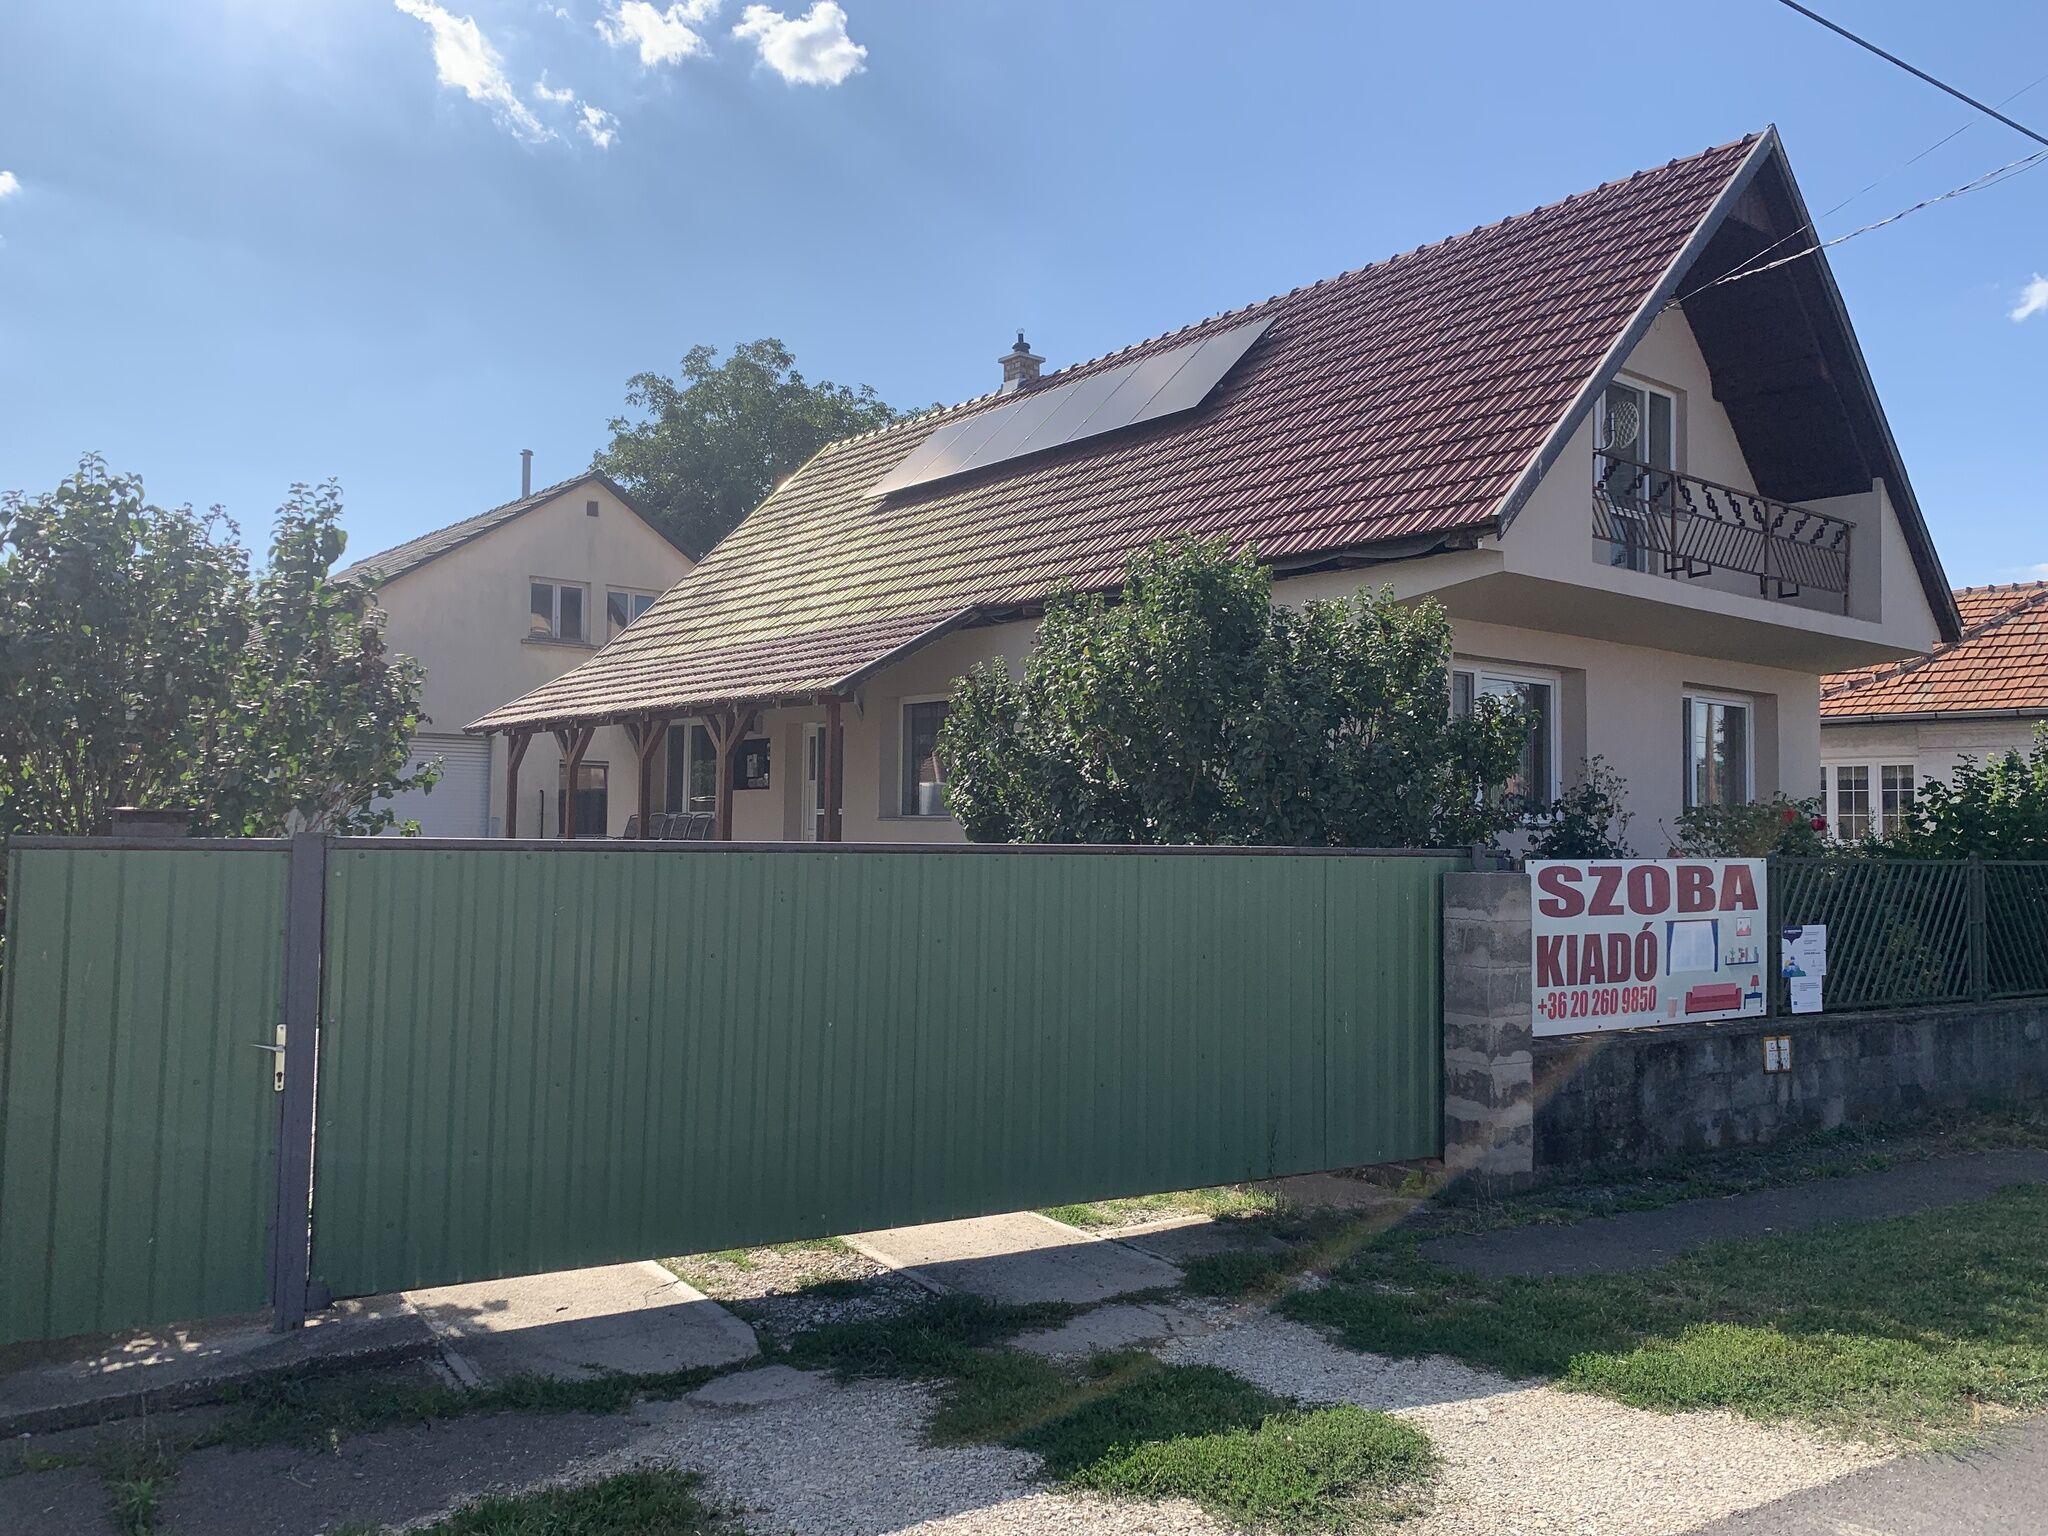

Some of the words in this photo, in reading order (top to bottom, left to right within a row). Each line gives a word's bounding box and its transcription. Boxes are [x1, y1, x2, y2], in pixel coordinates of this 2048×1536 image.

[1538, 865, 1758, 917] SZOBA
[1537, 922, 1657, 987] KIADÓ
[1538, 992, 1567, 1019] +36
[1570, 991, 1588, 1017] 20
[1592, 989, 1619, 1016] 260
[1622, 986, 1656, 1013] 9850
